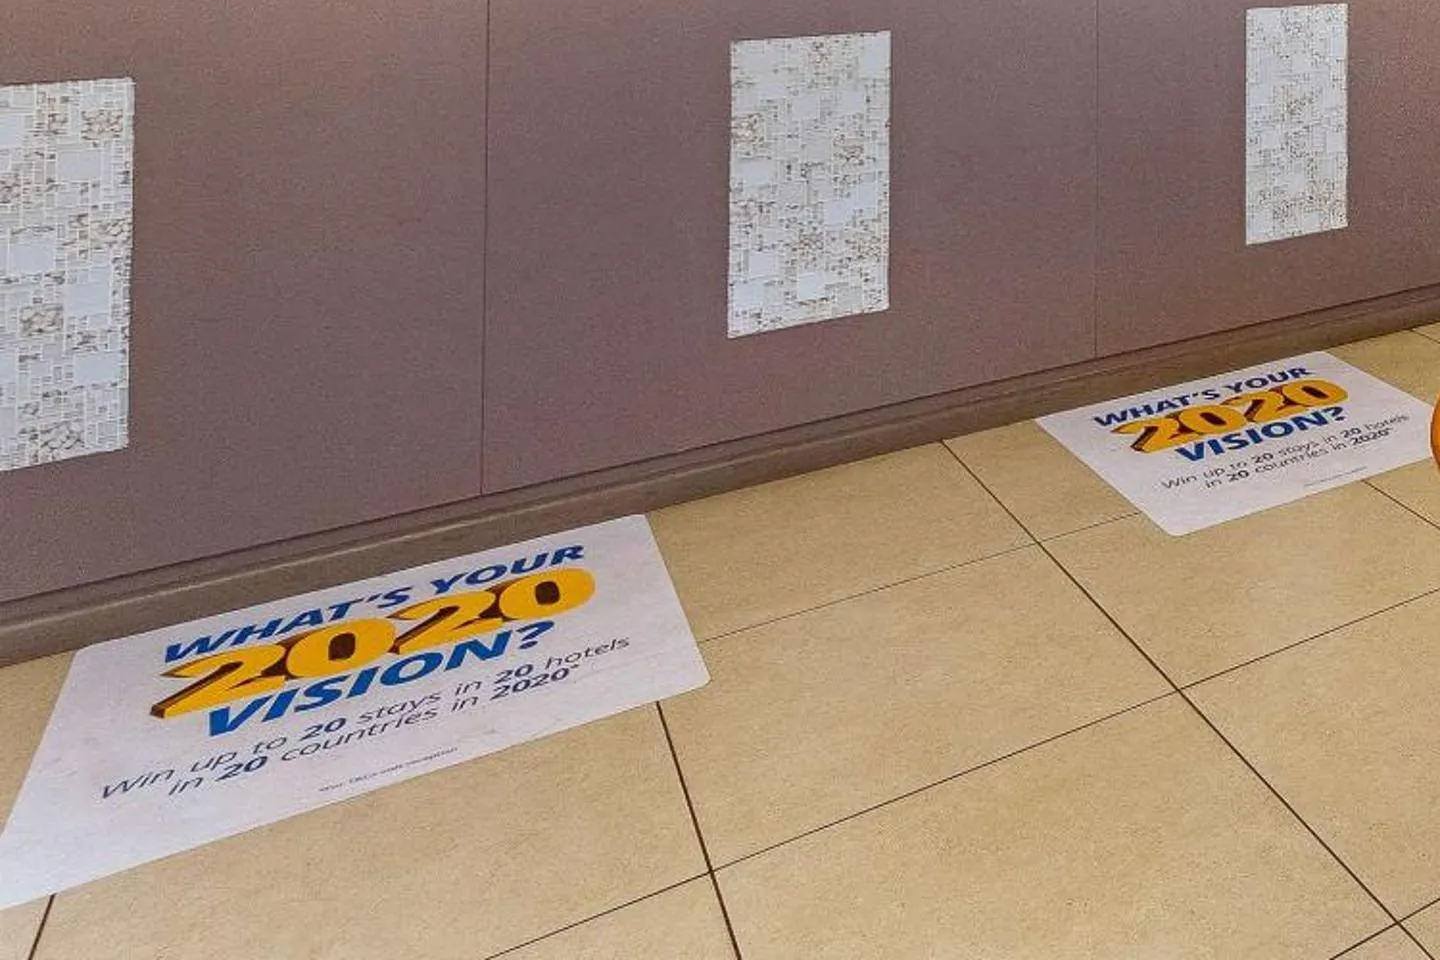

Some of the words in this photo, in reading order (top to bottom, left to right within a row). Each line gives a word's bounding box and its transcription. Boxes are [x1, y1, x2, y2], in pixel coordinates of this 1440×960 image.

[1093, 389, 1220, 427] WHAT'S
[1225, 367, 1312, 394] YOUR
[1110, 378, 1348, 453] 2020
[1174, 405, 1347, 462] VISION?
[1161, 475, 1197, 489] Win
[1203, 467, 1225, 479] up
[1230, 461, 1247, 470] to
[1251, 452, 1274, 464] 20
[1278, 441, 1320, 457] stays
[1323, 434, 1338, 444] in
[1340, 427, 1362, 439] 20
[1363, 414, 1409, 431] hotels
[1205, 479, 1222, 489] in
[1226, 470, 1250, 482] 20
[1255, 448, 1328, 473] countries
[1330, 442, 1347, 451] in
[150, 566, 596, 720] 2020
[165, 586, 412, 662] WHAT'S
[431, 544, 585, 595] YOUR
[102, 768, 174, 799] Win
[191, 750, 238, 774] up
[252, 736, 287, 755] to
[303, 717, 346, 740] 20
[359, 692, 441, 724] stays
[455, 679, 482, 697] in
[494, 663, 534, 685] 20
[546, 636, 631, 670] hotels
[208, 620, 555, 737] VISION?
[168, 776, 205, 796] in
[215, 755, 269, 782] 20
[280, 706, 438, 762] countries
[450, 697, 478, 713] in
